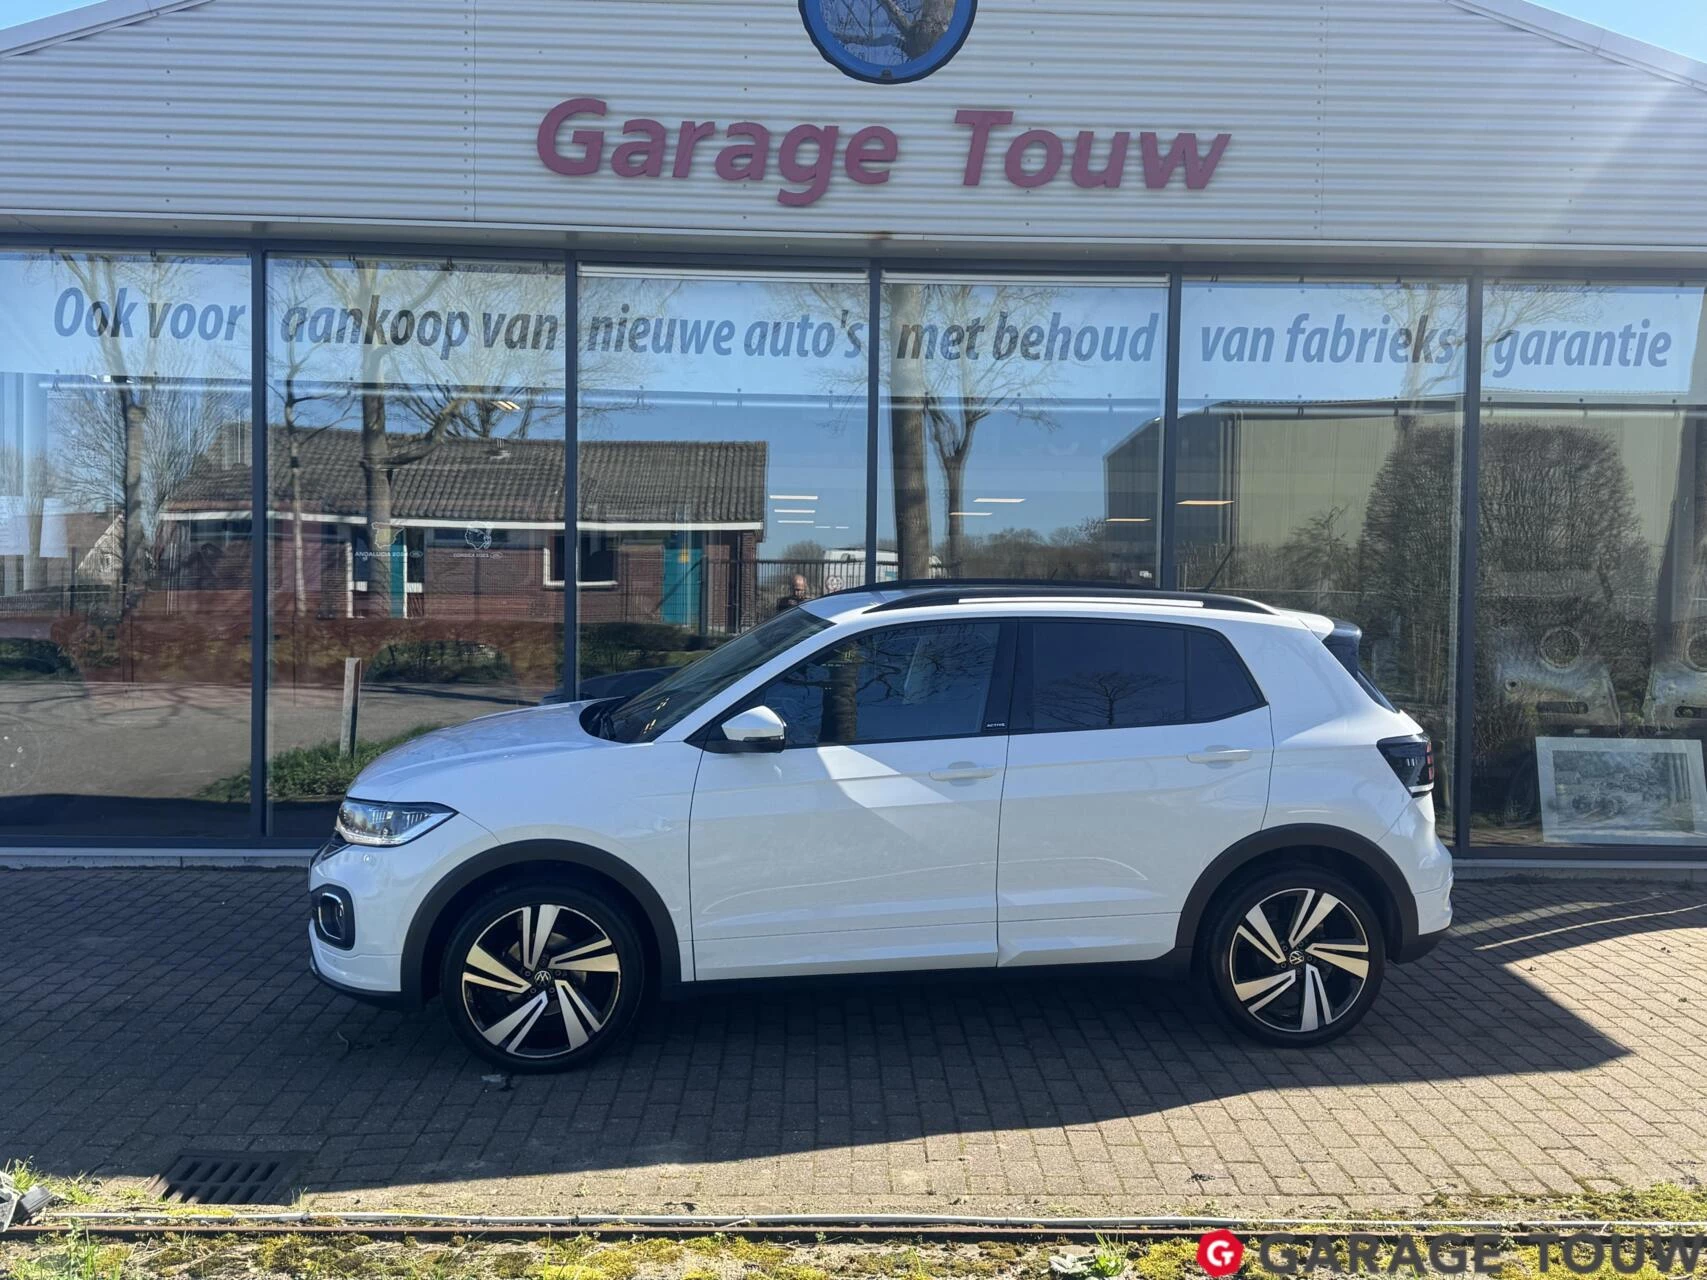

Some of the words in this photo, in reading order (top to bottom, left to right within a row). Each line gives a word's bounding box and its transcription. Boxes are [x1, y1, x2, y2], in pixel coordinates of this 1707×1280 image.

[537, 97, 899, 207] Garage
[954, 109, 1232, 190] Touw
[54, 286, 139, 338] Ook
[148, 301, 247, 341] voor
[280, 294, 470, 361] aankoop
[483, 311, 559, 350] van
[587, 303, 735, 356] nieuwe
[744, 309, 864, 358] auto's
[896, 314, 987, 361] met
[992, 311, 1159, 363] behoud
[1201, 324, 1275, 364] van
[1283, 312, 1458, 365] fabrieks
[1491, 318, 1672, 379] garantie
